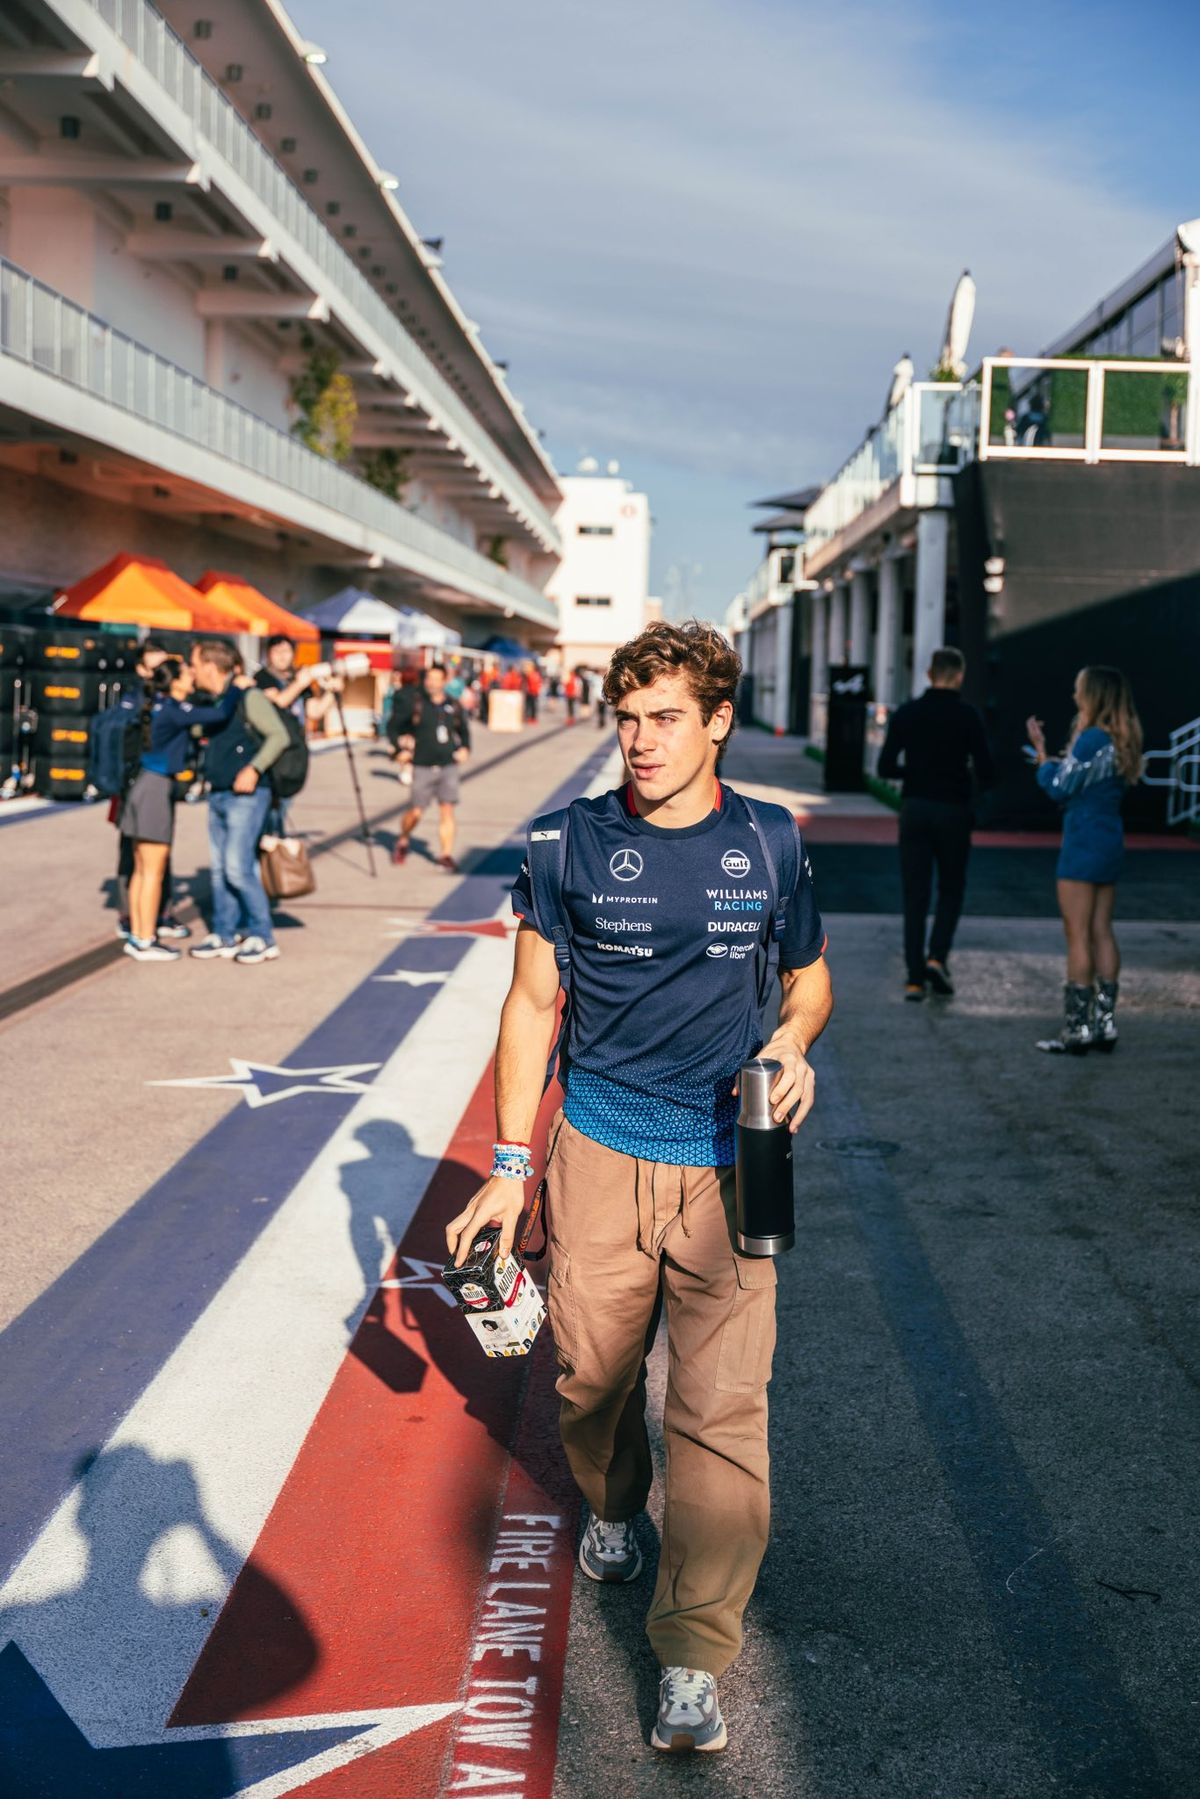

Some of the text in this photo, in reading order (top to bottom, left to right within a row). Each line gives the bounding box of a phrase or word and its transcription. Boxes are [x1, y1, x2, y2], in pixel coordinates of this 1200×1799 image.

[724, 859, 748, 868] Gulf
[606, 896, 658, 904] MYPROTEIN
[706, 889, 768, 900] WILLIAMS
[714, 901, 762, 911] RACING
[595, 916, 652, 933] Stephens
[597, 942, 653, 957] KOMATSU
[498, 1262, 518, 1296] NATURA
[448, 1513, 562, 1799] FIRE LANE TOW A
